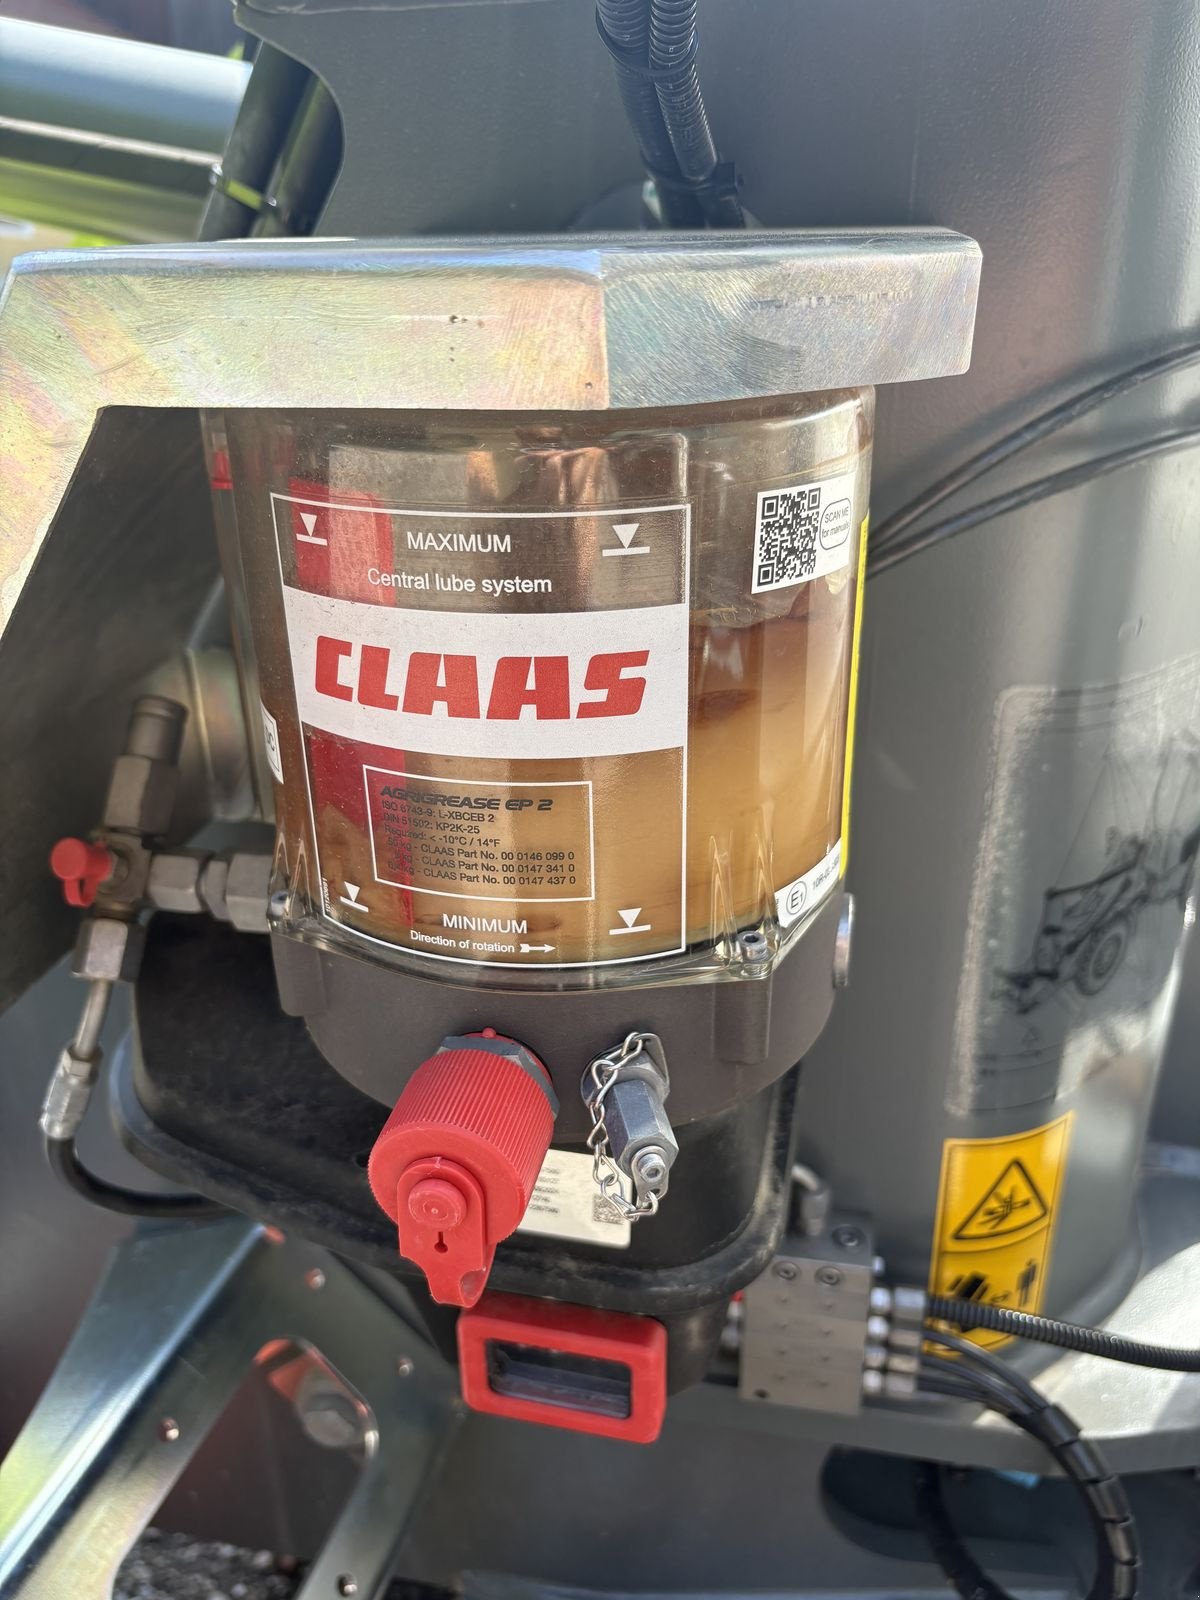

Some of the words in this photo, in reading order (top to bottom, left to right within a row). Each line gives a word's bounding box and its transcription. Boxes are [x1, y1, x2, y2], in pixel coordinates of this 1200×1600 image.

[825, 510, 841, 523] SCAN
[406, 531, 511, 553] MAXIMUM
[367, 567, 430, 590] Central
[435, 573, 476, 593] lube
[481, 576, 552, 597] system
[315, 635, 650, 721] CLAAS
[381, 785, 501, 810] AGRIGREASE
[505, 798, 534, 811] EP
[537, 798, 553, 811] 2
[382, 800, 398, 811] ISO
[400, 803, 436, 817] 6743-9:
[439, 810, 485, 822] L-XBCEB
[488, 813, 495, 822] 2
[383, 813, 399, 823] DIN
[401, 816, 433, 830] 51502:
[436, 822, 480, 834] KP2K-25
[384, 824, 427, 840] Required:
[439, 835, 467, 846] -10°C
[469, 837, 475, 847] /
[477, 838, 501, 847] 14°F
[421, 843, 455, 856] CLAAS
[457, 848, 477, 859] Part
[480, 850, 498, 860] No.
[501, 851, 514, 860] 00
[517, 852, 542, 860] 0146
[545, 852, 565, 860] 099
[568, 851, 575, 860] 0
[422, 856, 456, 868] CLAAS
[458, 860, 478, 870] Part
[481, 862, 499, 872] No.
[502, 864, 514, 873] 00
[517, 864, 543, 873] 0147
[545, 864, 564, 873] 341
[568, 863, 575, 872] 0
[423, 868, 457, 881] CLAAS
[459, 872, 479, 883] Part
[482, 874, 500, 884] No.
[503, 876, 515, 885] 00
[518, 876, 544, 885] 0147
[547, 876, 566, 885] 437
[569, 875, 576, 884] 0
[442, 913, 528, 934] MINIMUM
[410, 929, 456, 948] Direction
[459, 939, 470, 949] of
[473, 942, 515, 953] rotation
